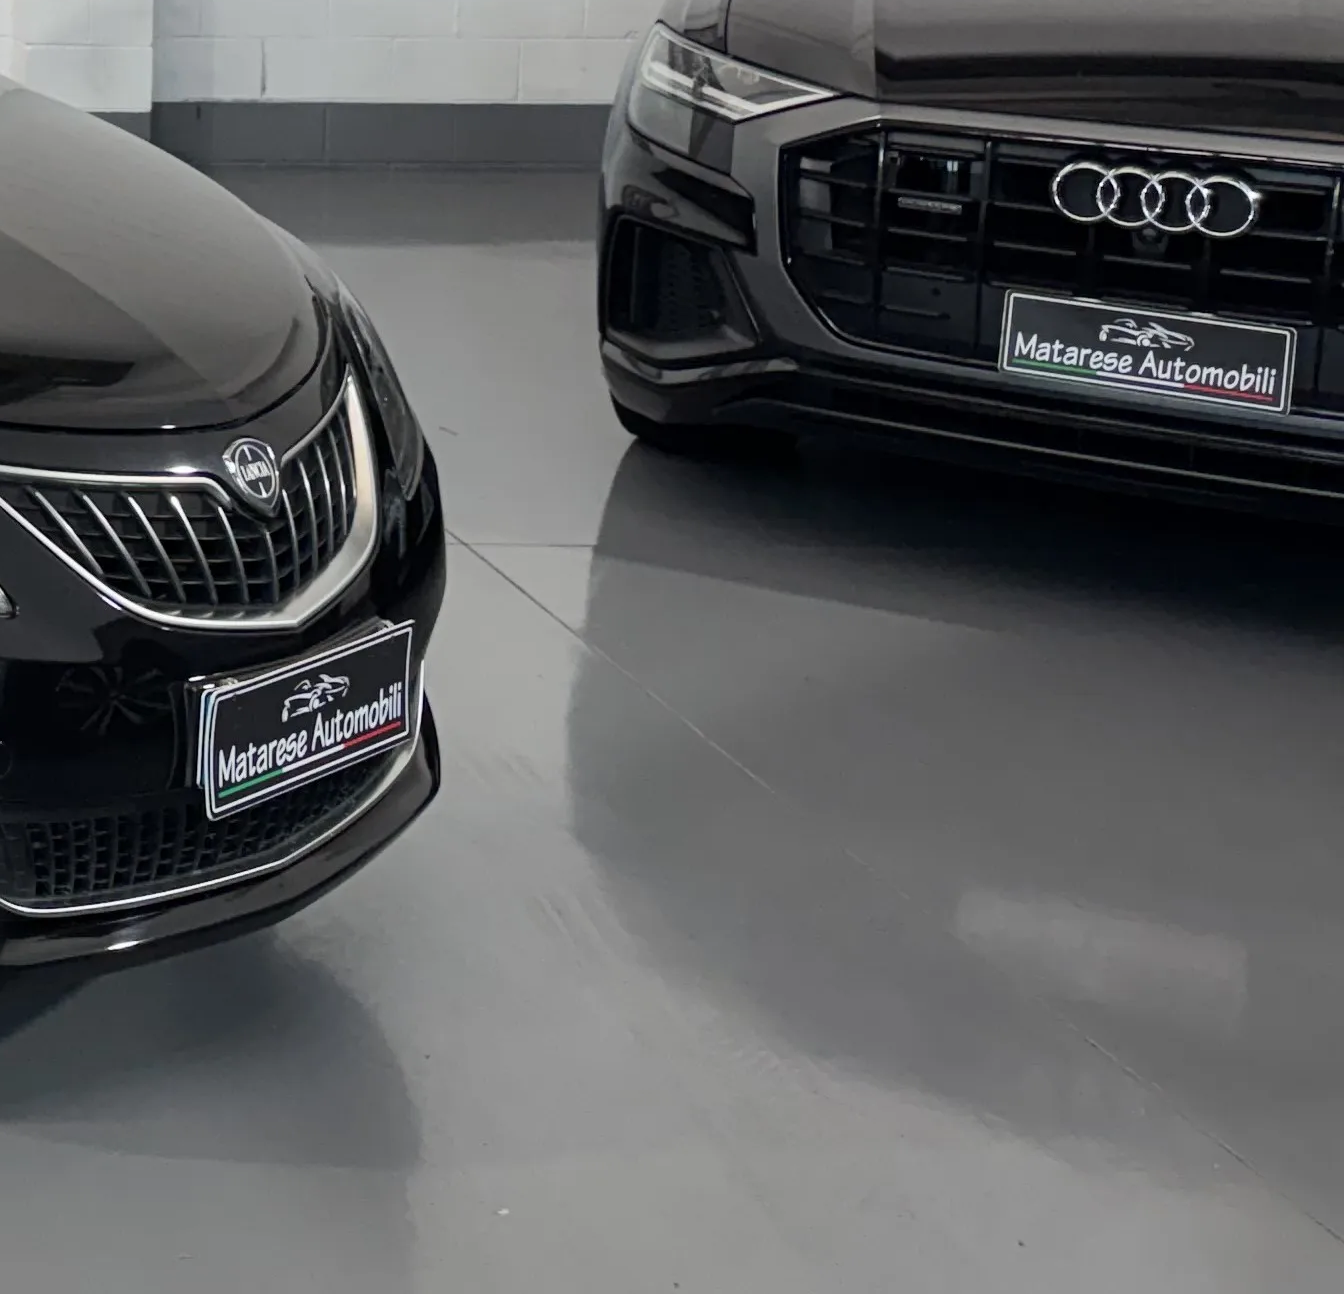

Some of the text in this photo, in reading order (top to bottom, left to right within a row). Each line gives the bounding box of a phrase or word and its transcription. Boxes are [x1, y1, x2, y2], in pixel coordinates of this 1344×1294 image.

[1014, 331, 1277, 395] Matarese Automobili
[218, 682, 402, 787] Matarese Automobili
